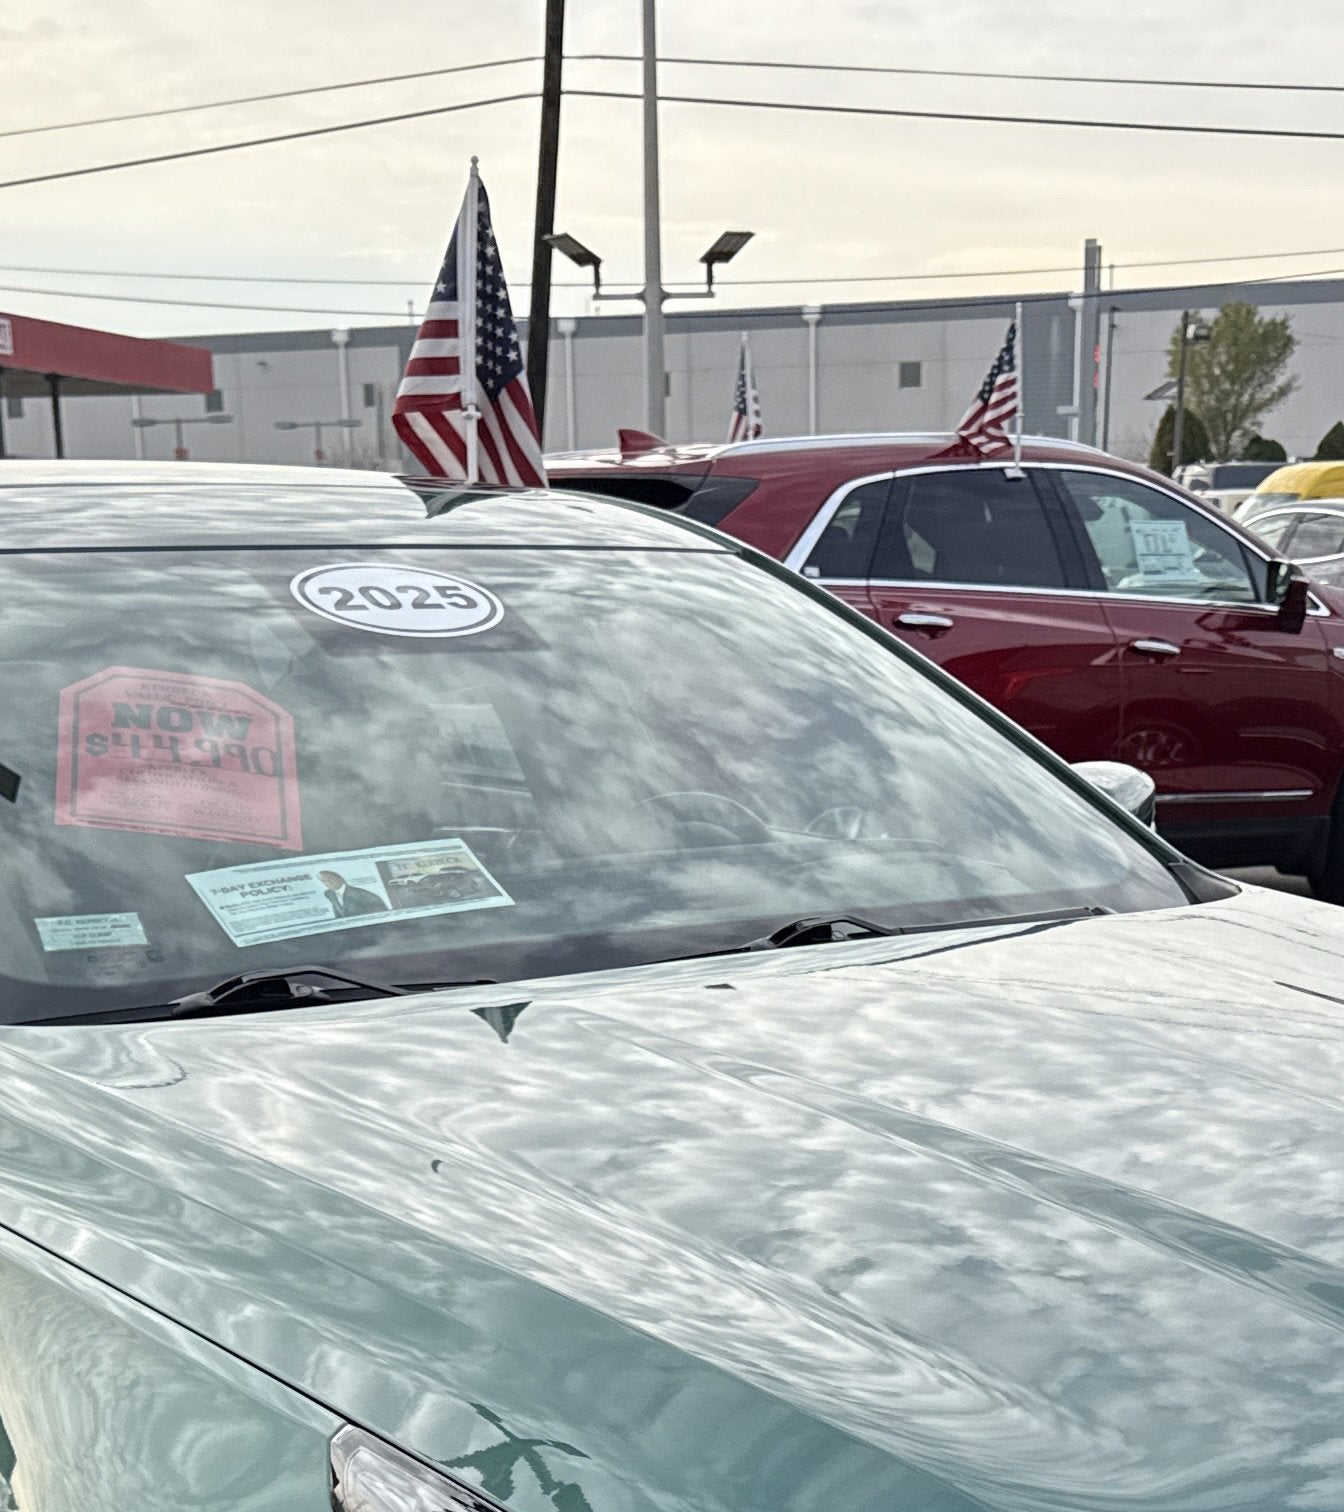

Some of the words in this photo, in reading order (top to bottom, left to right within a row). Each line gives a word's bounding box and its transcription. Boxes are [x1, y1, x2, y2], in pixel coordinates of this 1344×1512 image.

[317, 585, 478, 611] 2025
[111, 702, 253, 741] NOW
[209, 883, 246, 896] 7-DAY
[247, 874, 313, 889] EXCHANGE
